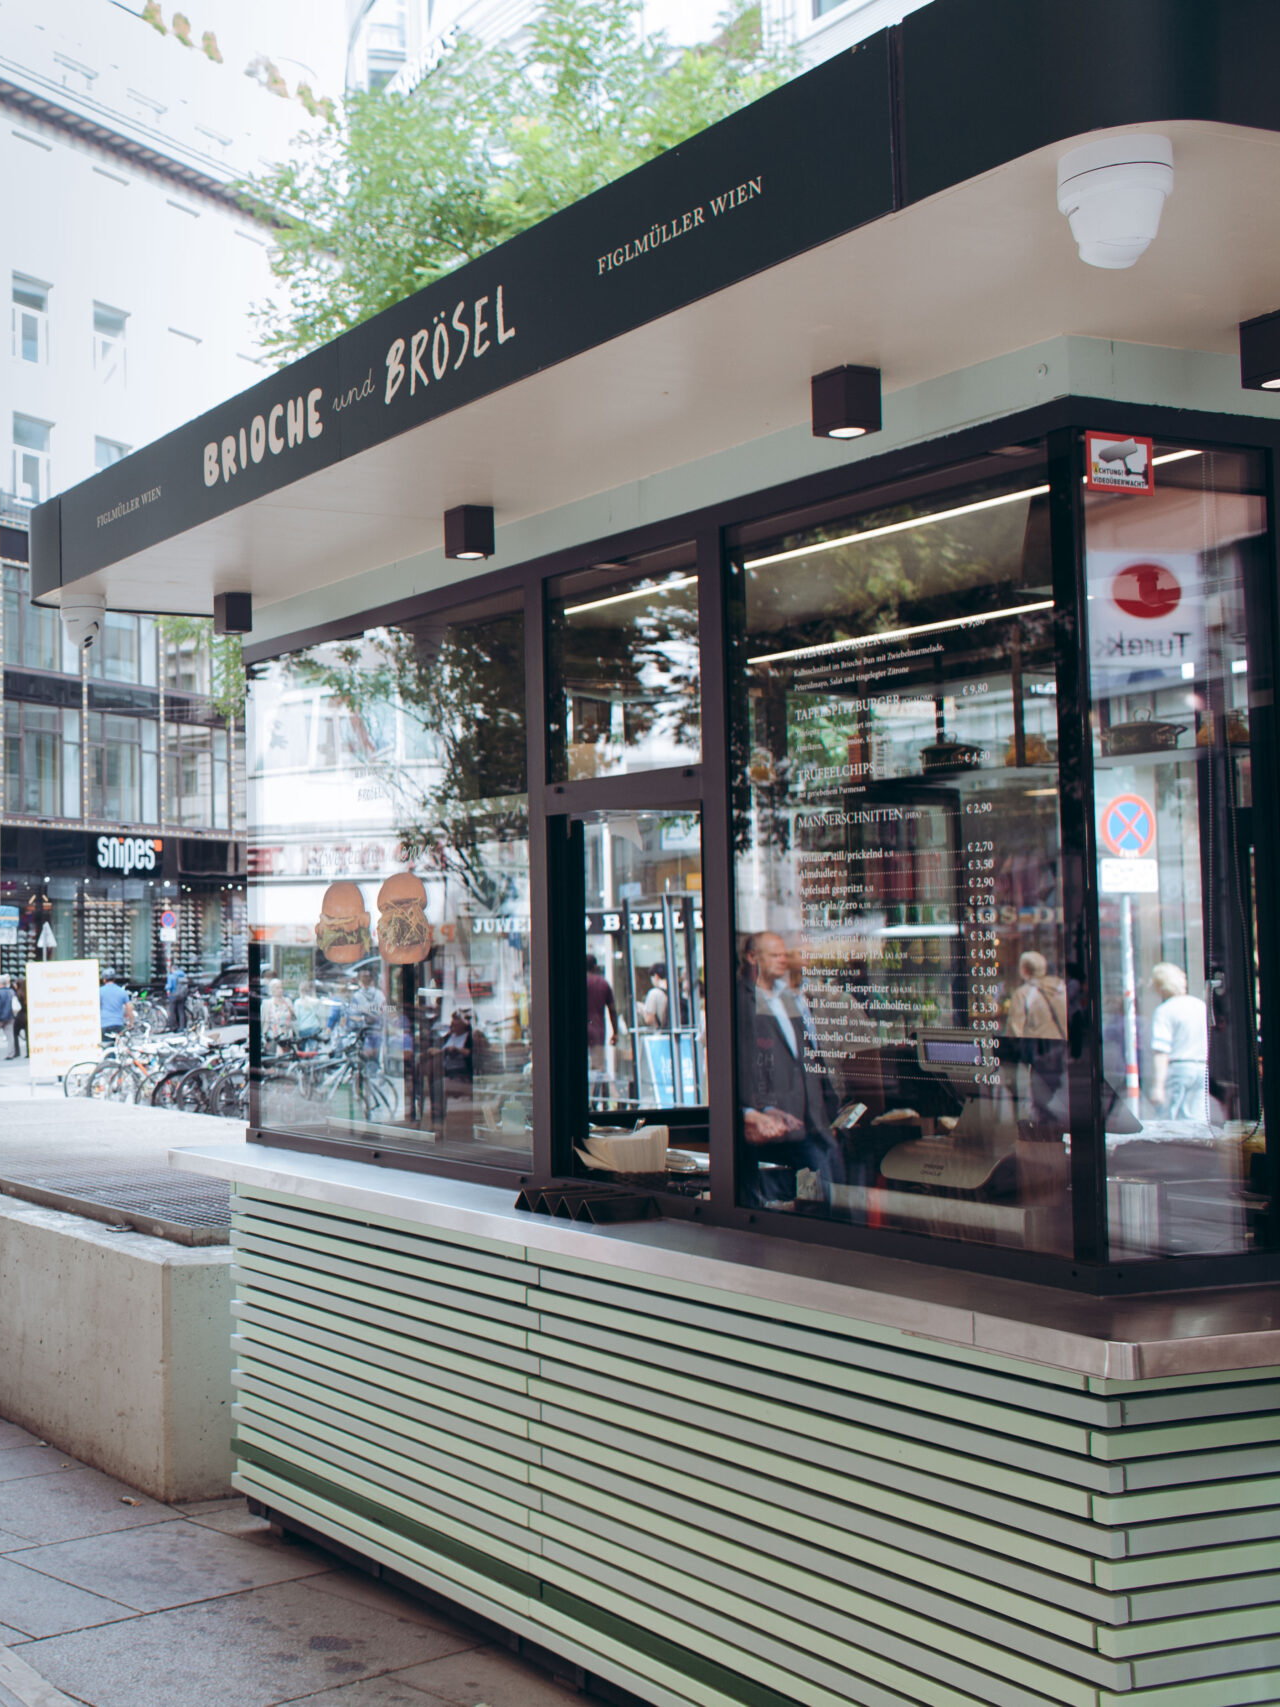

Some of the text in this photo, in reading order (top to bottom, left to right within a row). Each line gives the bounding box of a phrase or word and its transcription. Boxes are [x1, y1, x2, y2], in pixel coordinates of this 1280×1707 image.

[597, 176, 763, 275] FIGLMÜLLER WIEN
[203, 284, 516, 487] BRIOCHE und BRÖSEL
[96, 486, 162, 528] FIGLMÜLLER WIEN
[962, 685, 968, 696] €
[969, 683, 989, 695] 9,80
[964, 752, 970, 763] €
[972, 751, 991, 764] 4,50
[798, 808, 903, 828] MANNERSCHNITTEN
[966, 804, 972, 814] €
[973, 802, 993, 815] 2,90
[967, 842, 973, 852] €
[975, 840, 994, 853] 2,70
[97, 836, 156, 875] snipes
[800, 867, 837, 878] Almdudler
[968, 860, 974, 870] €
[975, 858, 994, 871] 3,50
[968, 877, 974, 888] €
[976, 876, 995, 888] 2,90
[968, 896, 975, 905] €
[976, 895, 995, 906] 2,70
[472, 916, 531, 934] JUWE
[970, 931, 976, 940] €
[978, 930, 996, 942] 3,80
[971, 949, 977, 959] €
[978, 948, 997, 960] 4,90
[802, 965, 839, 976] Budweiser
[971, 967, 977, 977] €
[978, 966, 997, 978] 3,80
[845, 983, 889, 996] Bierspritzer
[972, 984, 978, 994] €
[979, 984, 998, 996] 3,40
[972, 1002, 978, 1012] €
[979, 1002, 999, 1014] 3,30
[972, 1020, 979, 1030] €
[980, 1020, 999, 1031] 3,90
[844, 1032, 871, 1043] Classic
[973, 1038, 979, 1048] €
[980, 1038, 1000, 1049] 8,90
[804, 1047, 847, 1060] Jägermeister
[974, 1056, 980, 1066] €
[981, 1056, 1000, 1067] 3,70
[804, 1063, 827, 1074] Vodka
[974, 1074, 980, 1084] €
[981, 1073, 1001, 1086] 4,00
